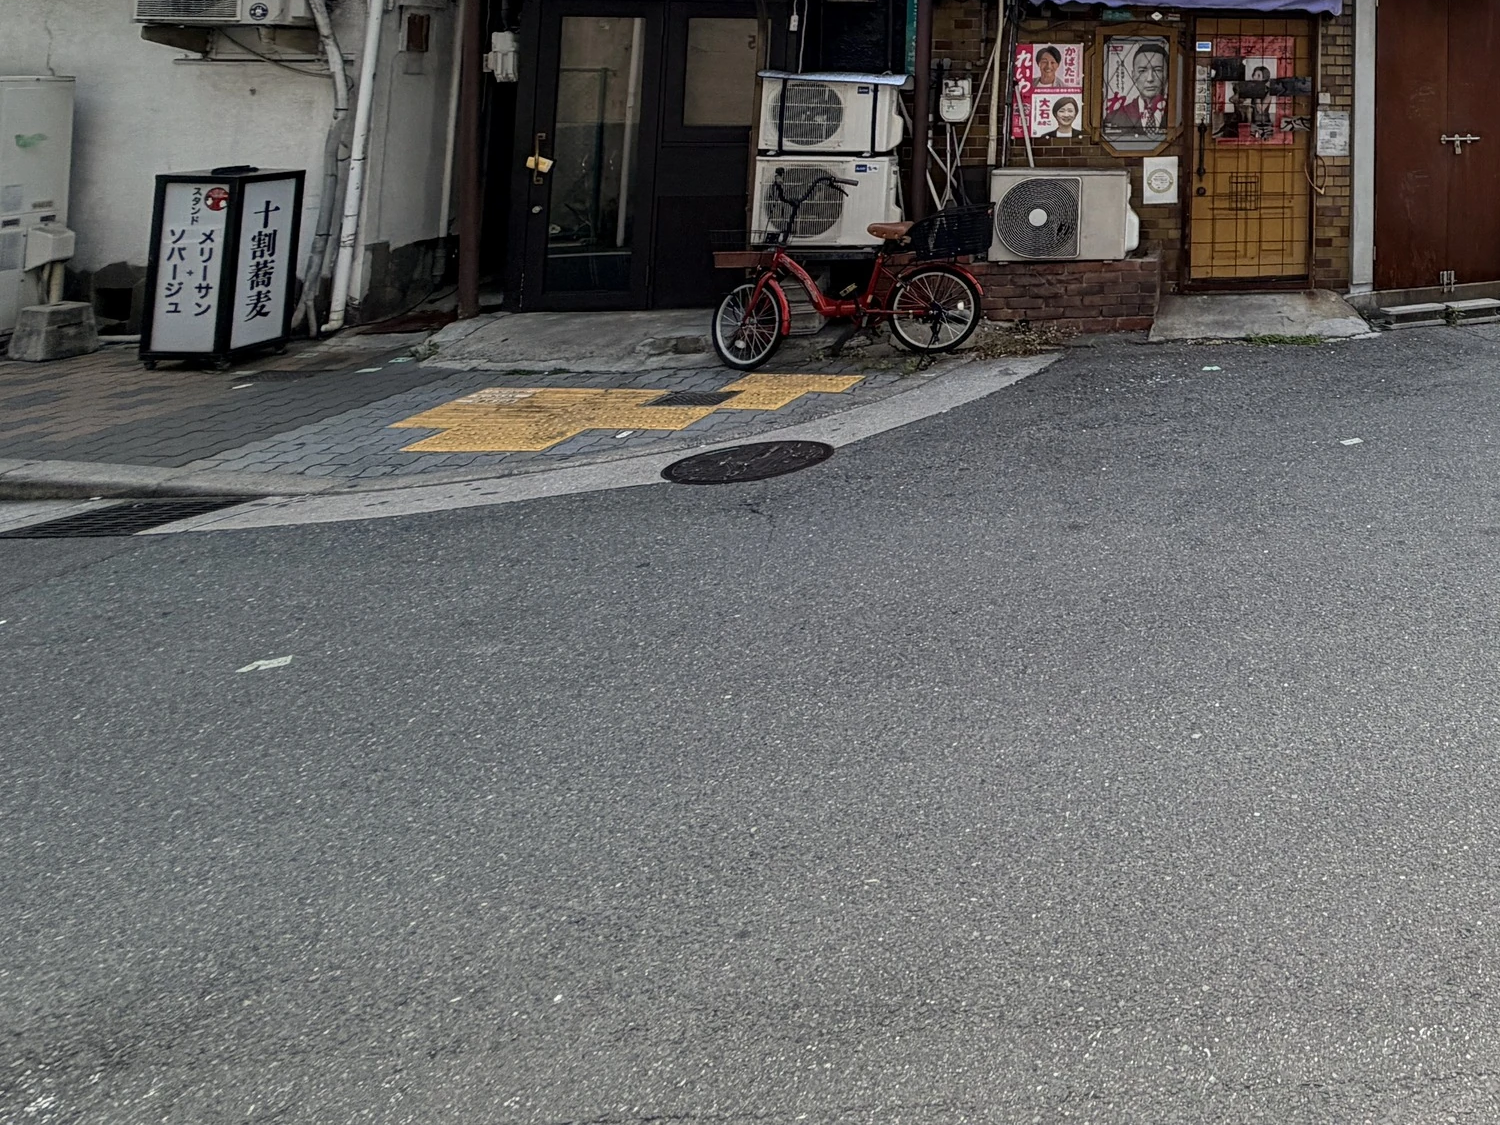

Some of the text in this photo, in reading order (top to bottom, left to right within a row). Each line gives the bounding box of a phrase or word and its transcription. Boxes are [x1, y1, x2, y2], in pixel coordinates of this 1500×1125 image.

[1014, 49, 1032, 93] れいわ
[1063, 46, 1076, 77] かばた
[1038, 97, 1051, 120] 大石
[190, 187, 203, 226] スタンド
[164, 229, 187, 314] ソバージュ
[193, 229, 215, 317] メリーサン
[244, 200, 281, 323] 十割蕎麦
